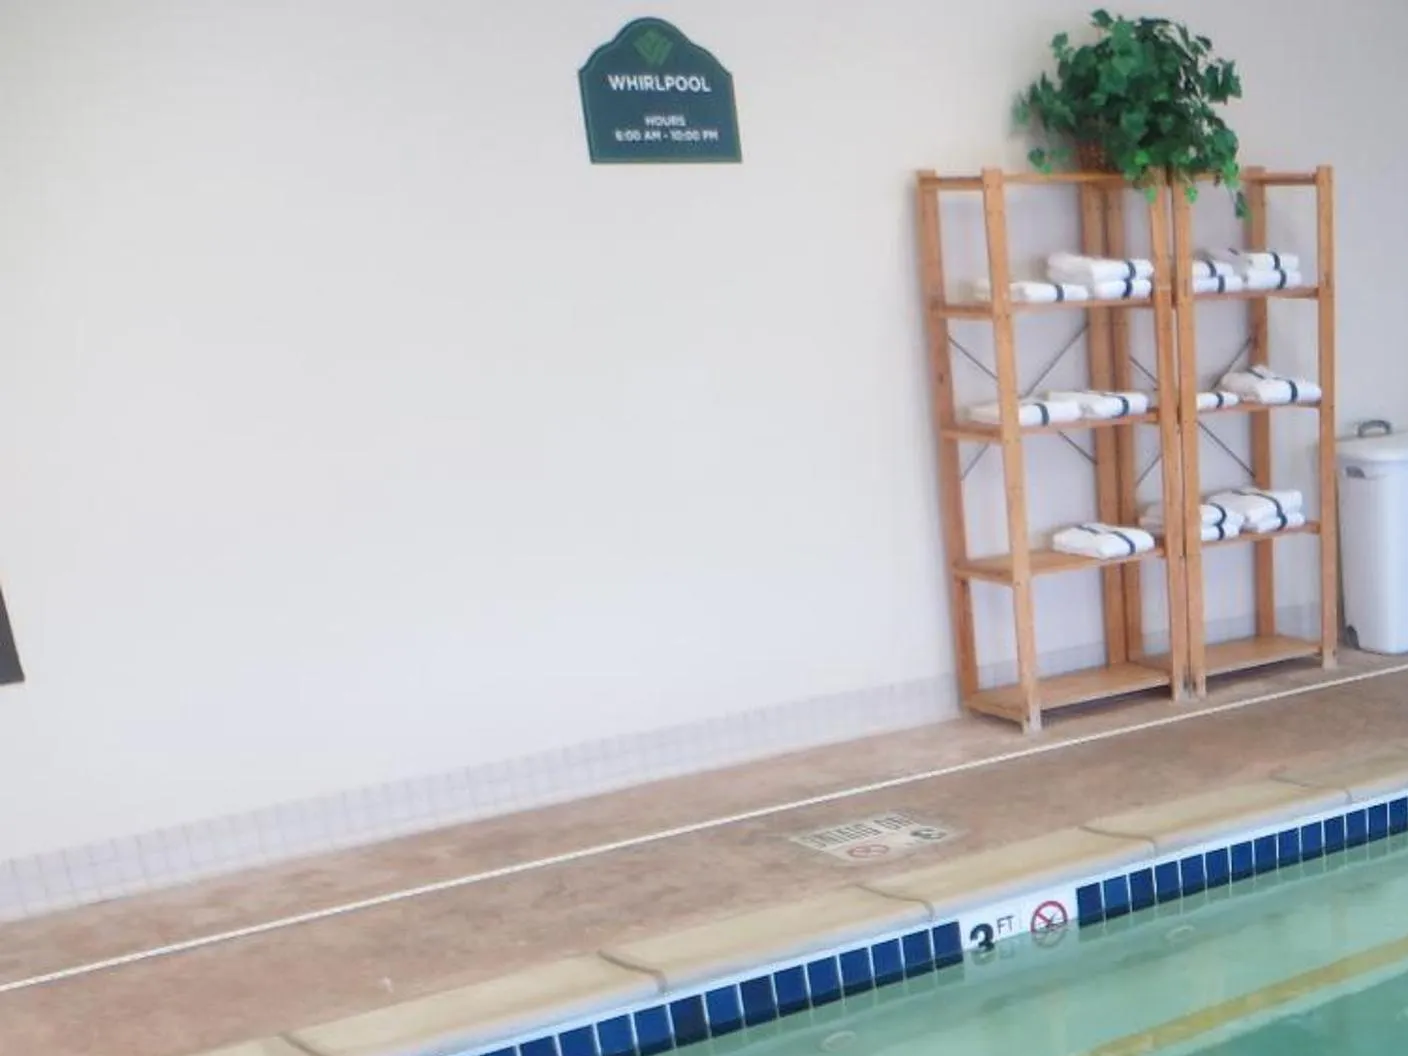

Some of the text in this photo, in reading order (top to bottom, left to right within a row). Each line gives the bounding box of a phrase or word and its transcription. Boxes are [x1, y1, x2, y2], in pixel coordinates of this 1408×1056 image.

[608, 74, 712, 93] WHIRLPOOL
[644, 114, 687, 127] HOURS
[643, 130, 661, 142] AM
[703, 130, 720, 142] PM
[968, 913, 1015, 952] 3 FT
